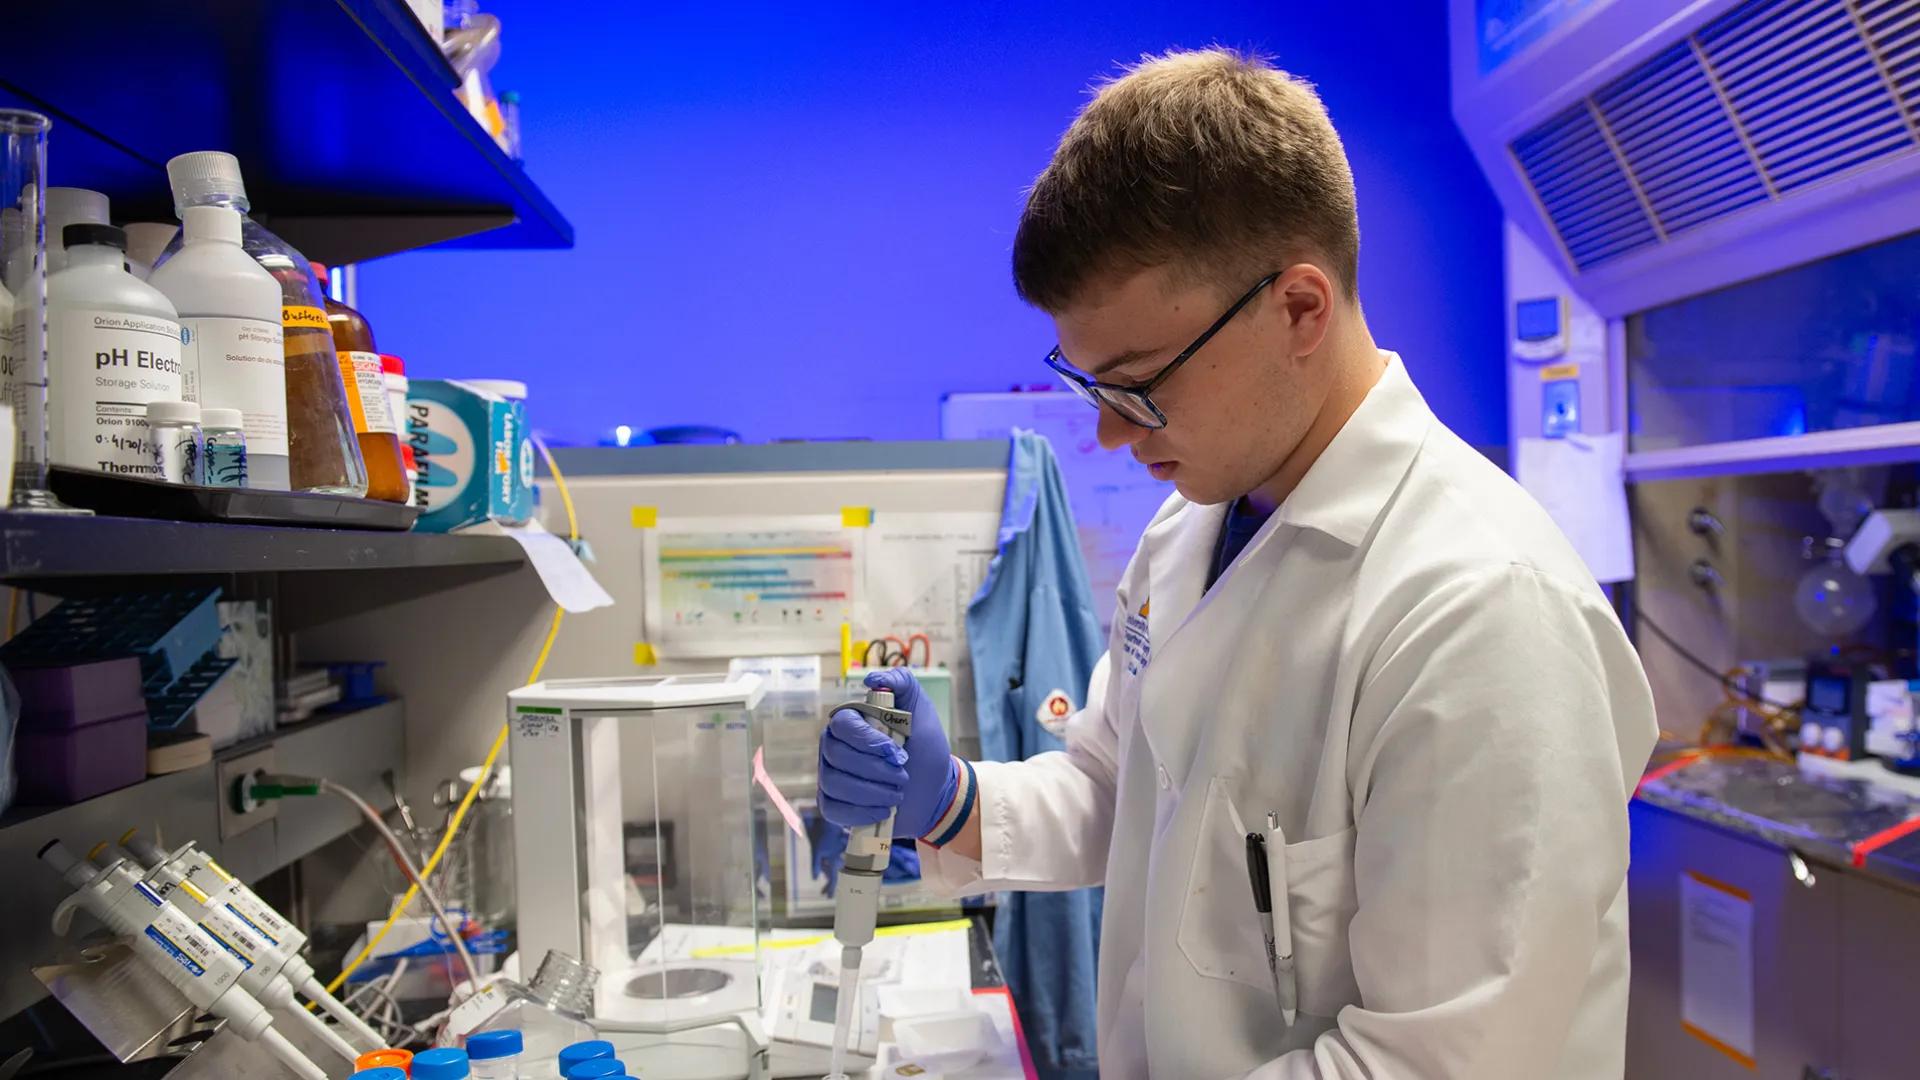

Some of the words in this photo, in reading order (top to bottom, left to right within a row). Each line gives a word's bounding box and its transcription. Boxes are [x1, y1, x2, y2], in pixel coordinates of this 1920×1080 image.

[94, 316, 121, 326] Orion
[123, 319, 165, 332] Application
[95, 348, 128, 370] pH
[137, 350, 181, 375] Electro
[225, 354, 256, 362] Solution
[95, 376, 137, 390] Storage
[140, 379, 170, 392] Solution
[96, 417, 123, 425] Orion
[503, 413, 513, 504] LABORATORY
[214, 971, 231, 987] 1000
